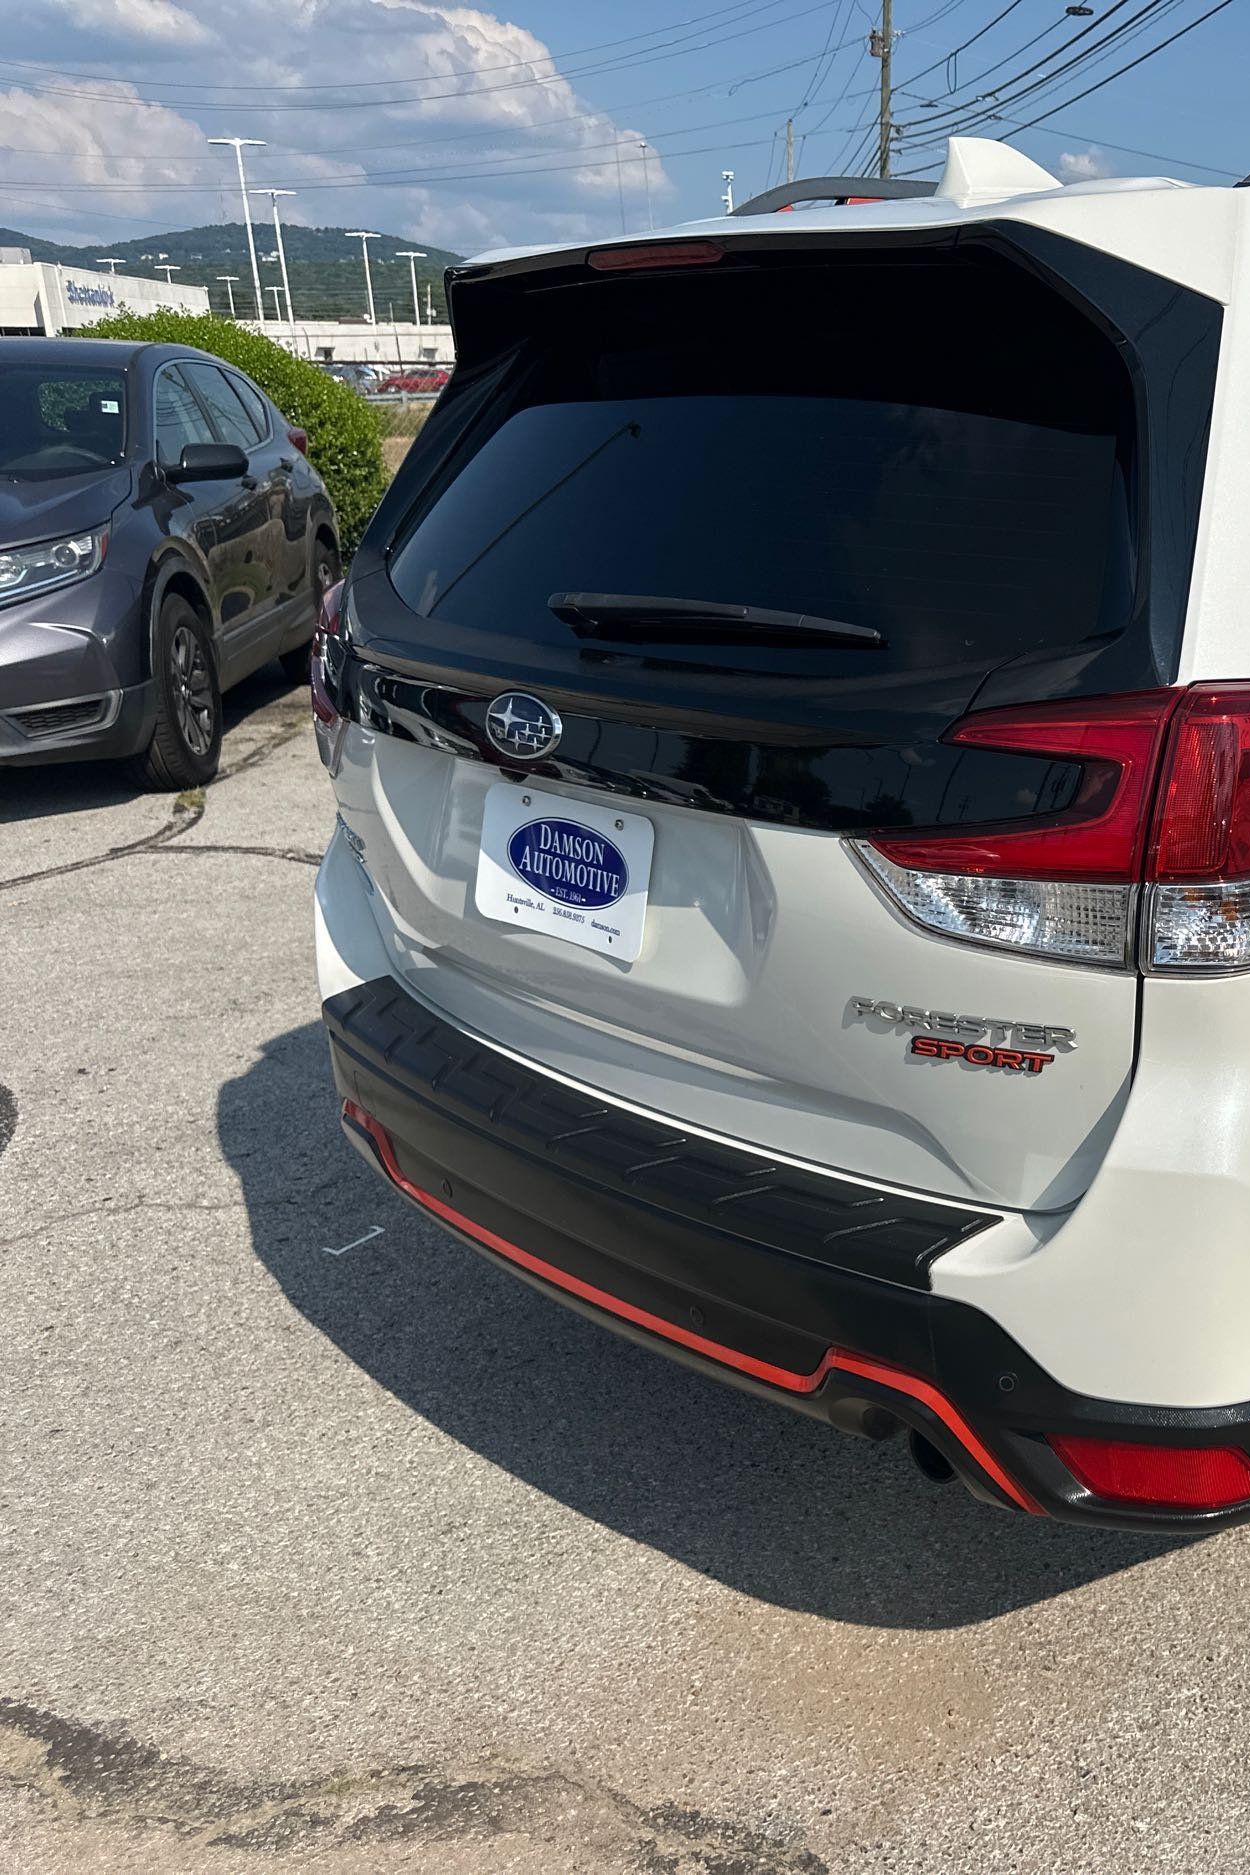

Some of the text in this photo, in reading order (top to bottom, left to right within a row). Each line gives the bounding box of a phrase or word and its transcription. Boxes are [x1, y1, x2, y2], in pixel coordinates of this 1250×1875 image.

[539, 823, 605, 866] DAMSON
[518, 845, 620, 898] AUTOMOTIVE
[850, 995, 1079, 1050] FORESTER
[910, 1035, 1055, 1073] SPORT
